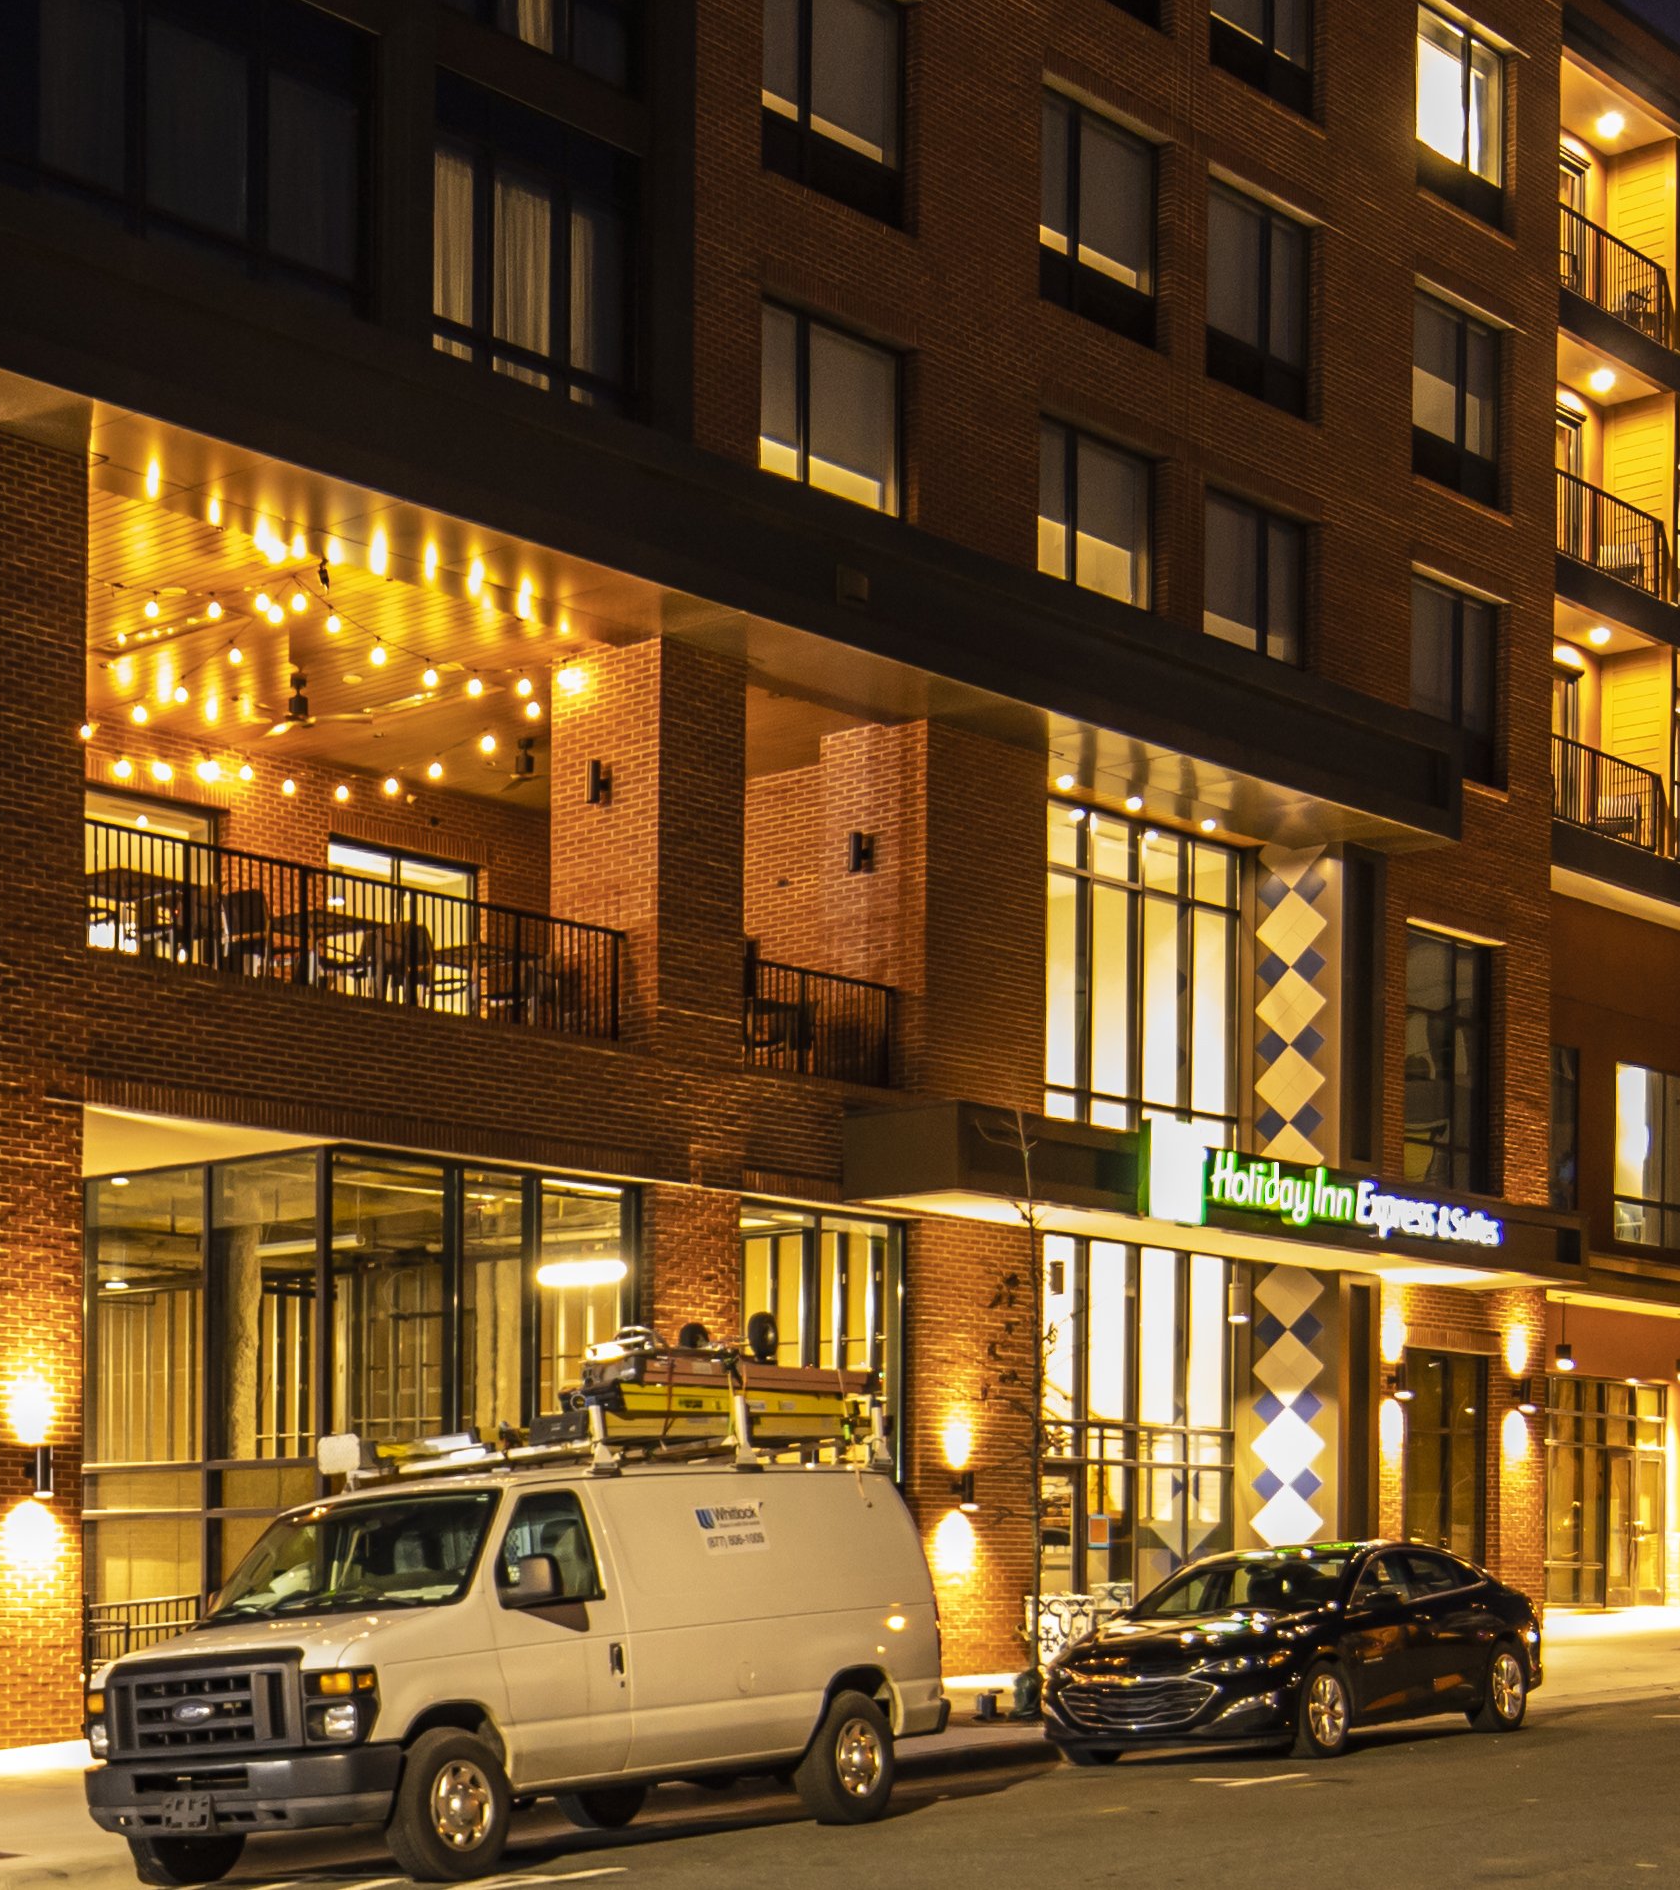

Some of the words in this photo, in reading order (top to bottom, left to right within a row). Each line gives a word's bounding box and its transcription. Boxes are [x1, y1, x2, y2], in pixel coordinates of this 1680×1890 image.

[1210, 1150, 1311, 1225] Holiday
[1313, 1166, 1355, 1221] Inn
[1355, 1180, 1438, 1239] Express
[1450, 1207, 1502, 1246] Suites
[713, 1506, 758, 1521] Whitlock
